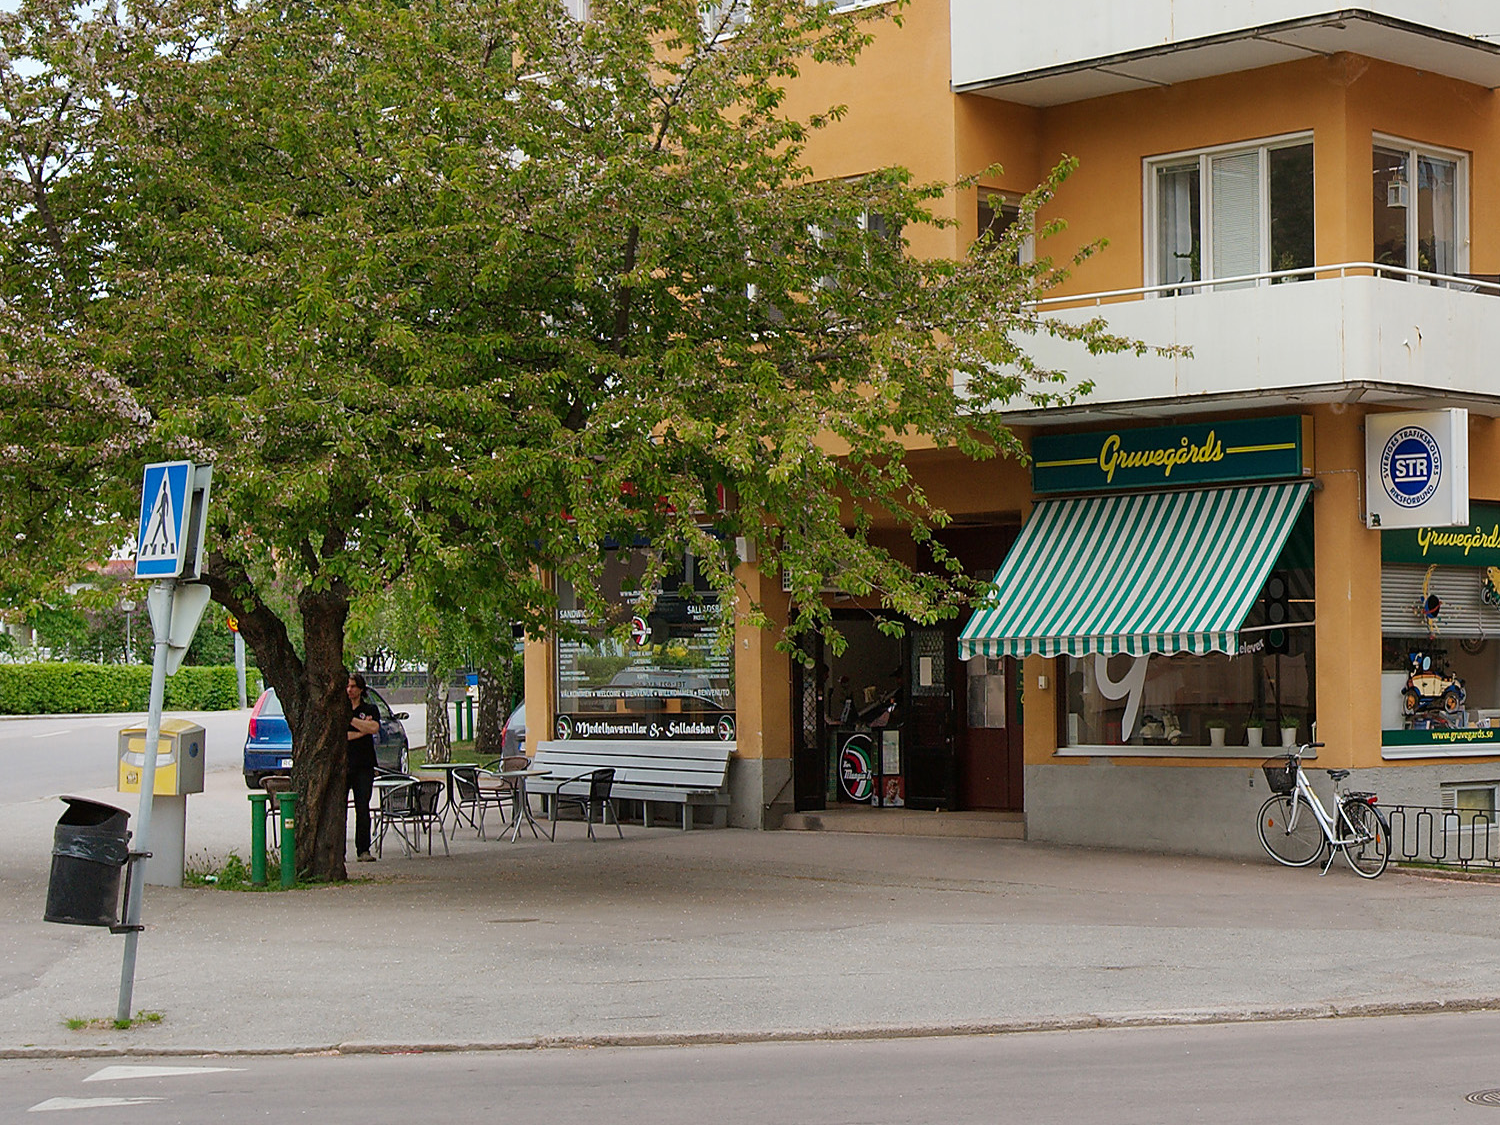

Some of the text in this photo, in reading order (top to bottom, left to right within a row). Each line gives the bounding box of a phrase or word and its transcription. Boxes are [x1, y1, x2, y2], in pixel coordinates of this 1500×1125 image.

[1100, 430, 1223, 483] Gruvegårds
[1383, 430, 1439, 479] SVERIGES TRAFIKSKOLORS
[1395, 458, 1428, 477] STR
[1390, 484, 1434, 505] RIKSFÖRBUND
[649, 722, 664, 738] &
[665, 721, 714, 738] Salladsbar
[1431, 729, 1494, 742] www.gruvegards.se
